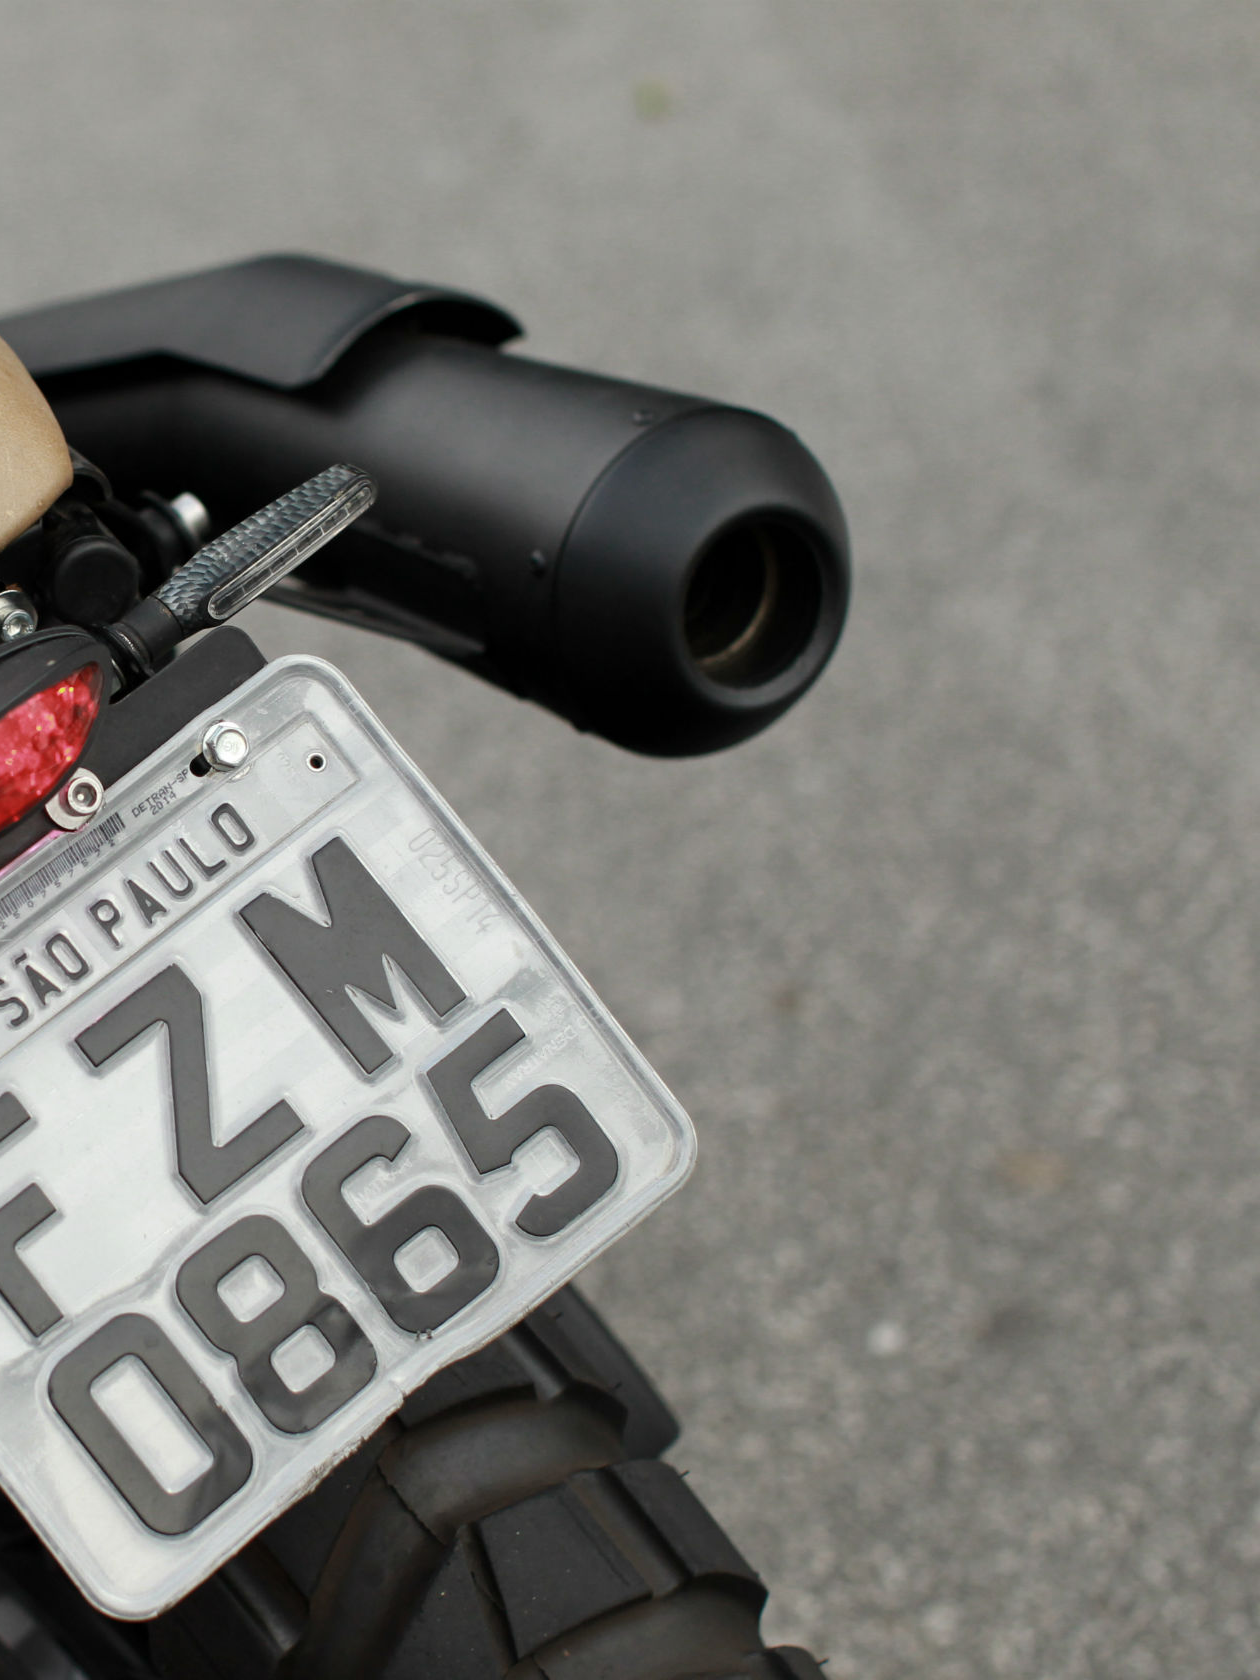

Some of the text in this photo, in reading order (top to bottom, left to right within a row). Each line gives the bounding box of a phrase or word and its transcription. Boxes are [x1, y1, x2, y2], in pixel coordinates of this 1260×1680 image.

[132, 768, 189, 818] DETRAN-SP
[151, 791, 177, 816] 2014
[88, 802, 255, 947] PAULO
[48, 1007, 619, 1538] 0865
